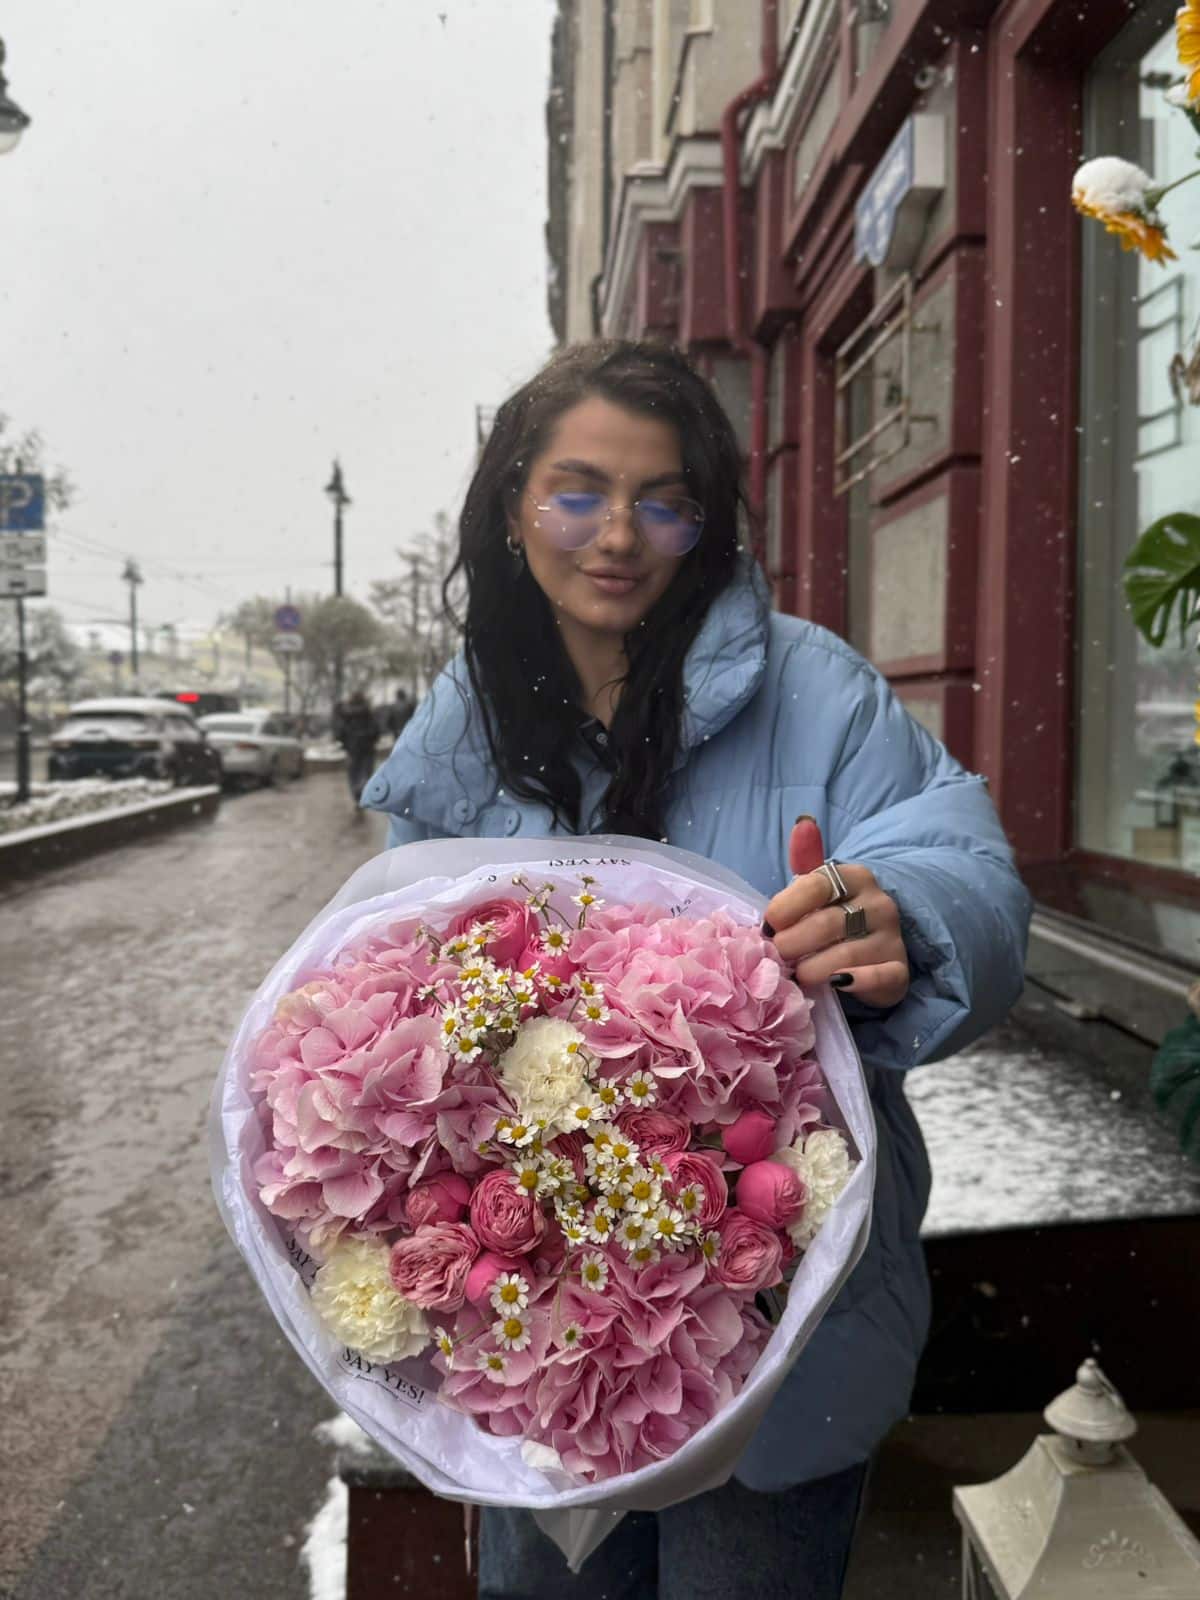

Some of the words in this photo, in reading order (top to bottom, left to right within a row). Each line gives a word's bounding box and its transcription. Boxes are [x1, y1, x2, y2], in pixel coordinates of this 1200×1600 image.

[595, 857, 632, 867] SAY
[342, 1346, 378, 1374] SAY
[383, 1367, 425, 1405] YES!
